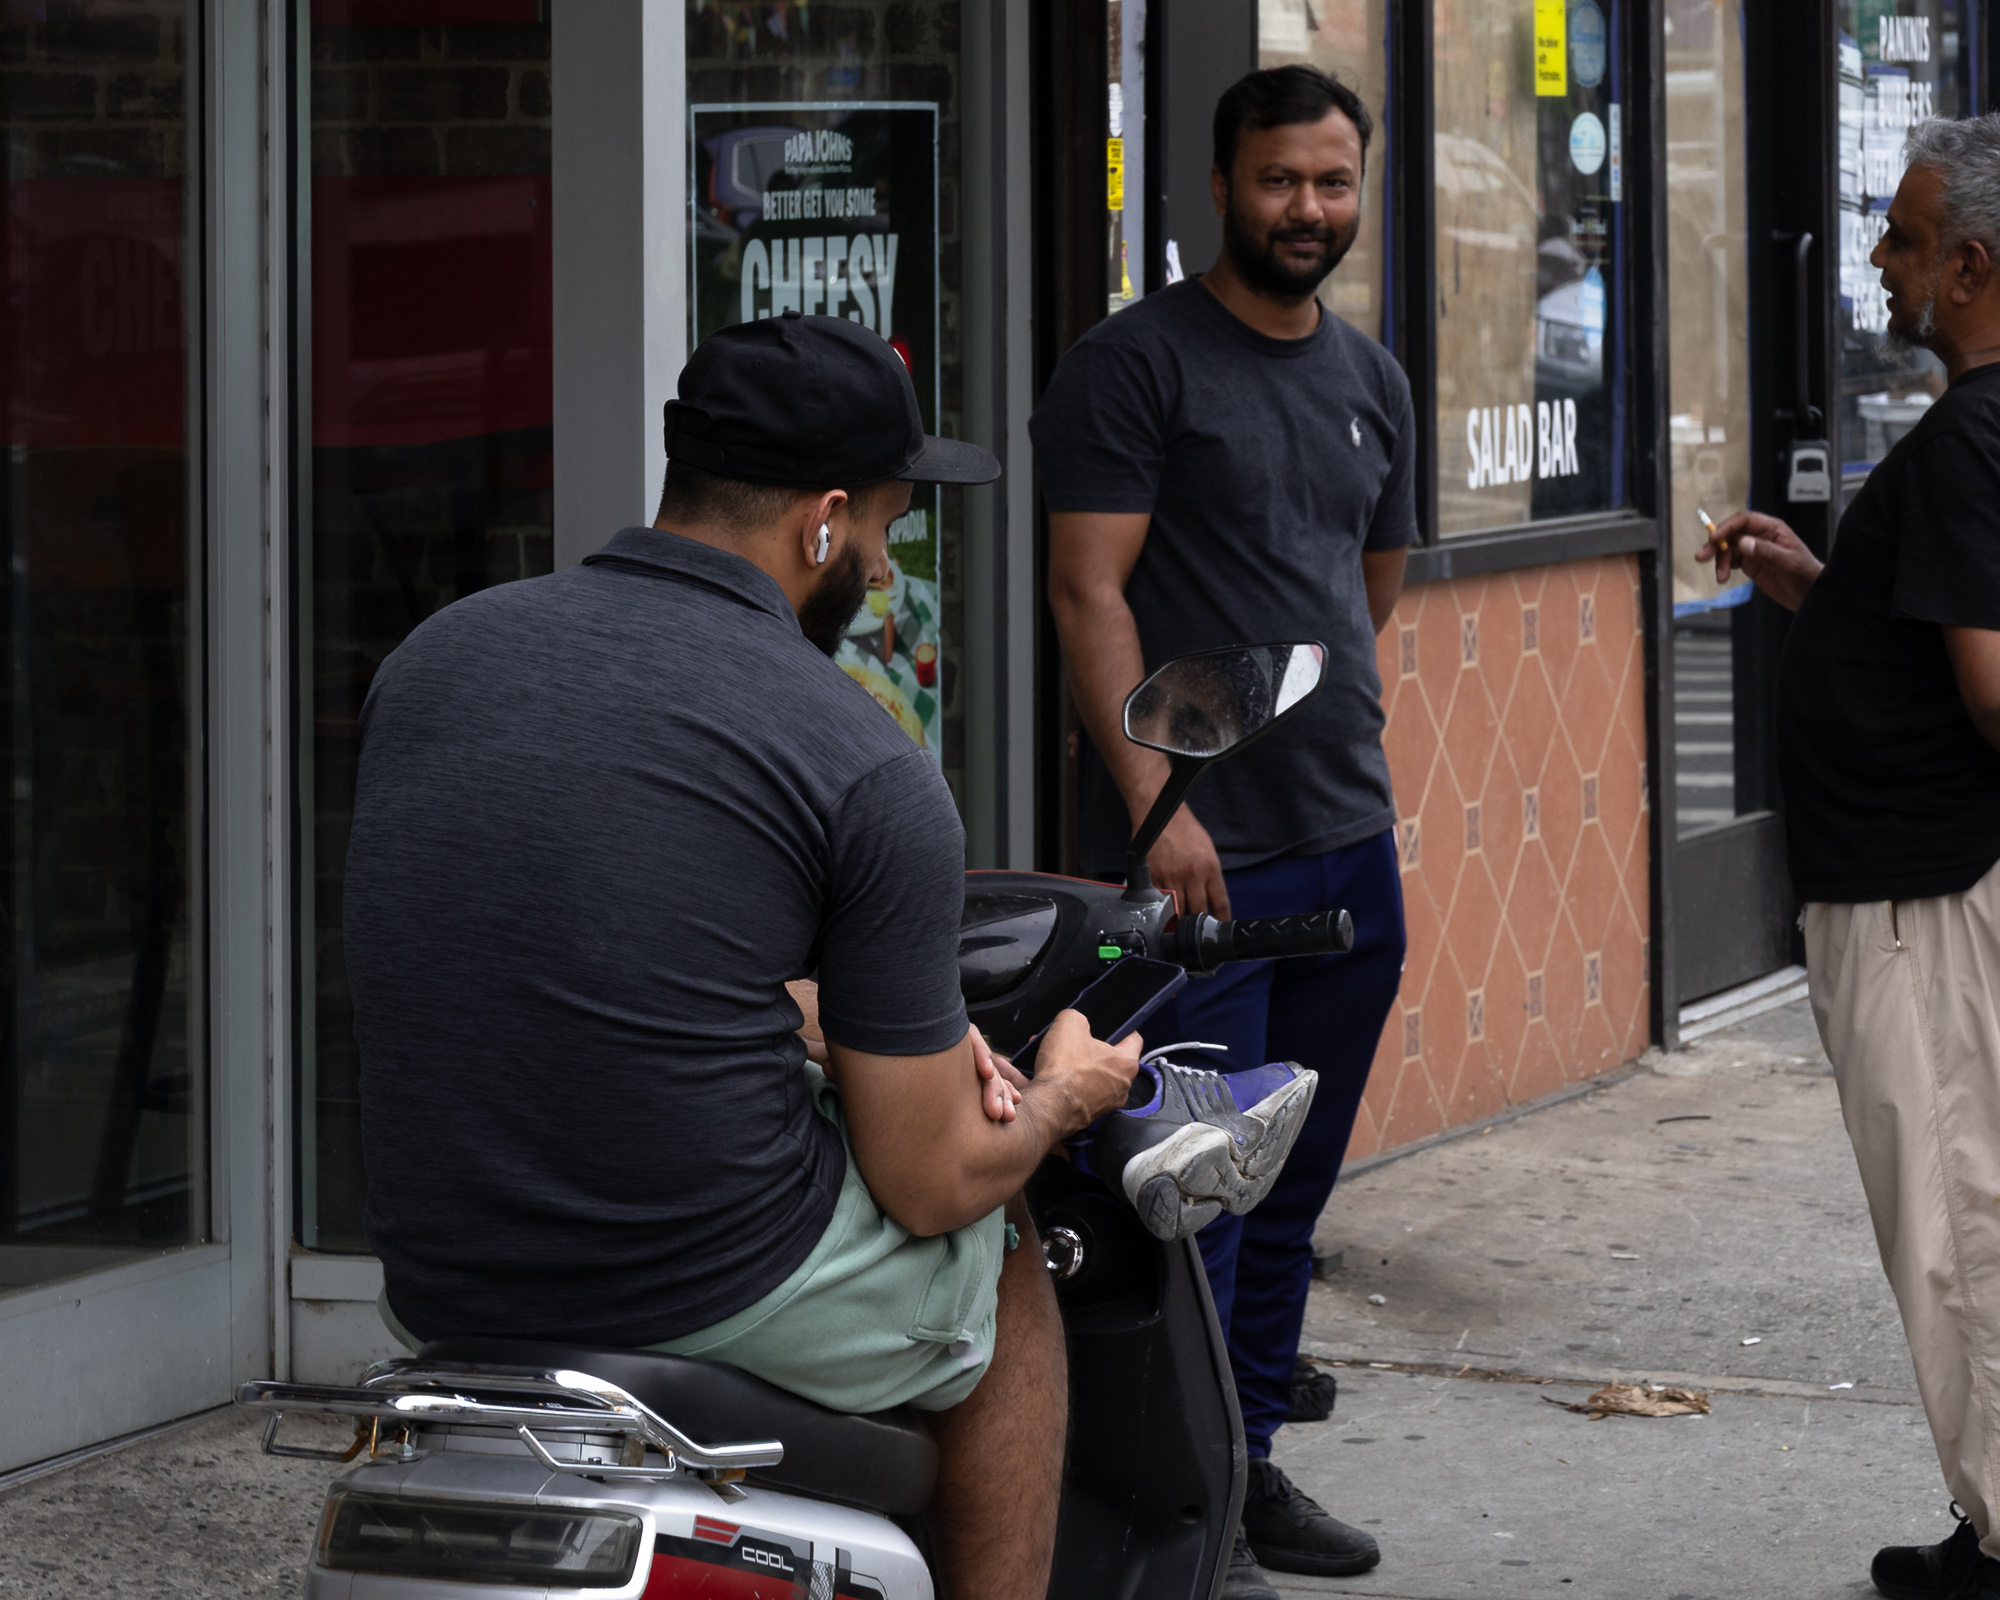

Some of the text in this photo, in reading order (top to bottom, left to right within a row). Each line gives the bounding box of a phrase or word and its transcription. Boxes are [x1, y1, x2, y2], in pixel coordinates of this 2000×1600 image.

[784, 129, 852, 162] PAPA JOHNS
[763, 187, 876, 220] BETTER GET YOU SOME
[741, 233, 898, 341] CHEESY
[1467, 398, 1579, 490] SALAD BAR
[742, 1546, 794, 1572] COOL
